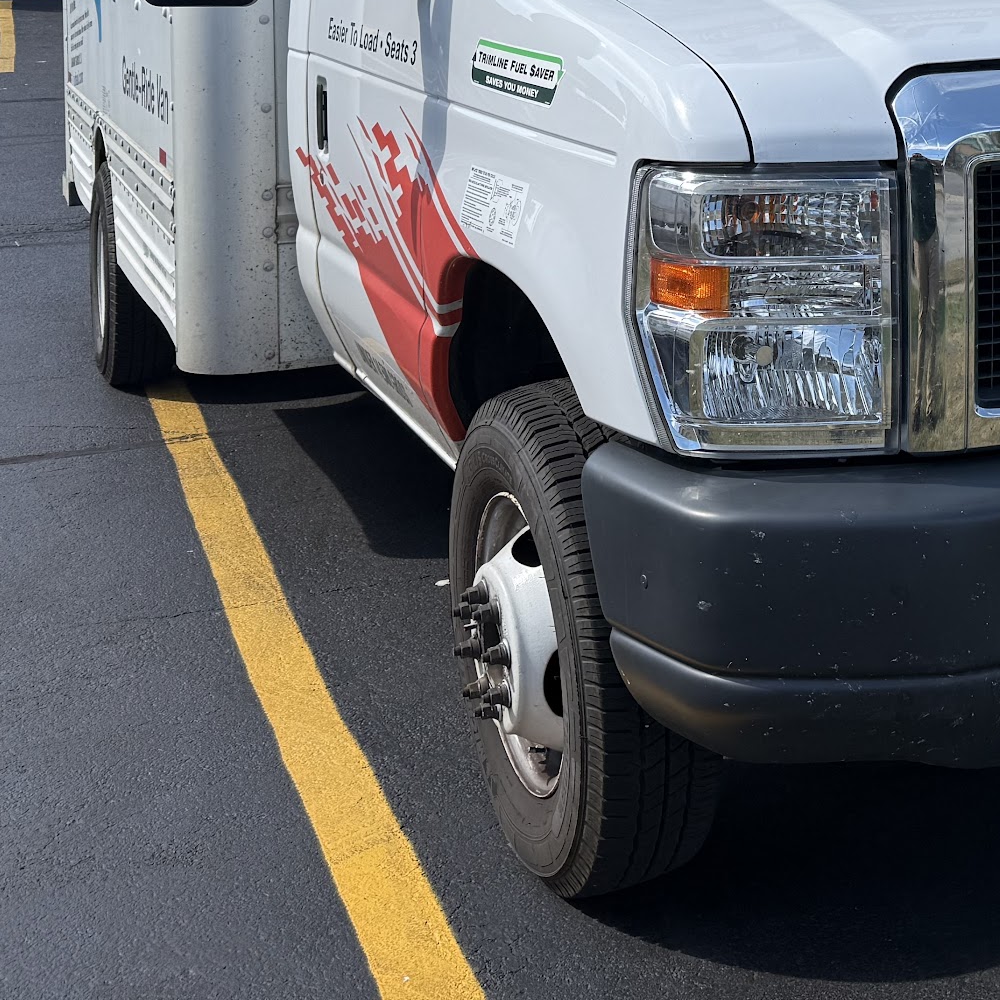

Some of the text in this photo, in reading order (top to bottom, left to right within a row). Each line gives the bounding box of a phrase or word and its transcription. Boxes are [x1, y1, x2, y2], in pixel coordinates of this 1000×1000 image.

[328, 17, 417, 65] Easier To Load Seats 3
[478, 51, 509, 70] TRIMLINE
[510, 60, 528, 75] FUEL
[122, 55, 155, 115] Gentle-Ride
[157, 73, 169, 125] Van
[485, 75, 539, 98] SAVES YOU MONEY
